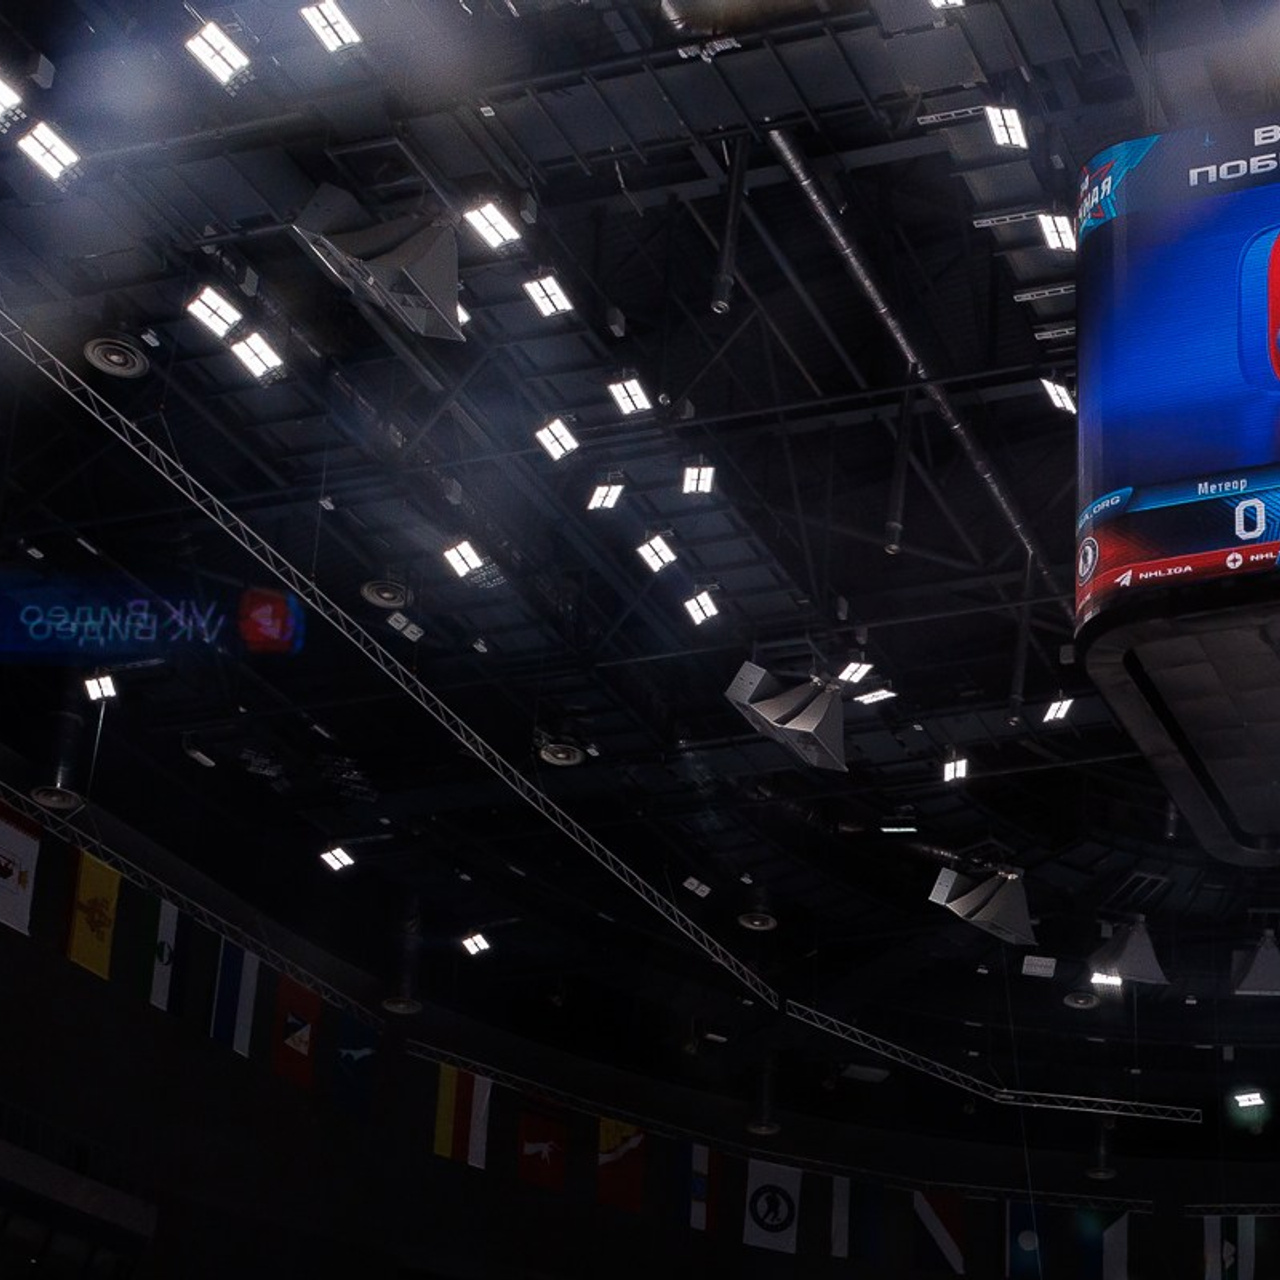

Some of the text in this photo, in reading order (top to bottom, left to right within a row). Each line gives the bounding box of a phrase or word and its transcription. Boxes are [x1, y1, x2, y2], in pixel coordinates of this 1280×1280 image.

[1197, 478, 1248, 496] Метеор
[1235, 498, 1266, 541] 0
[1139, 565, 1193, 580] NHLIGA
